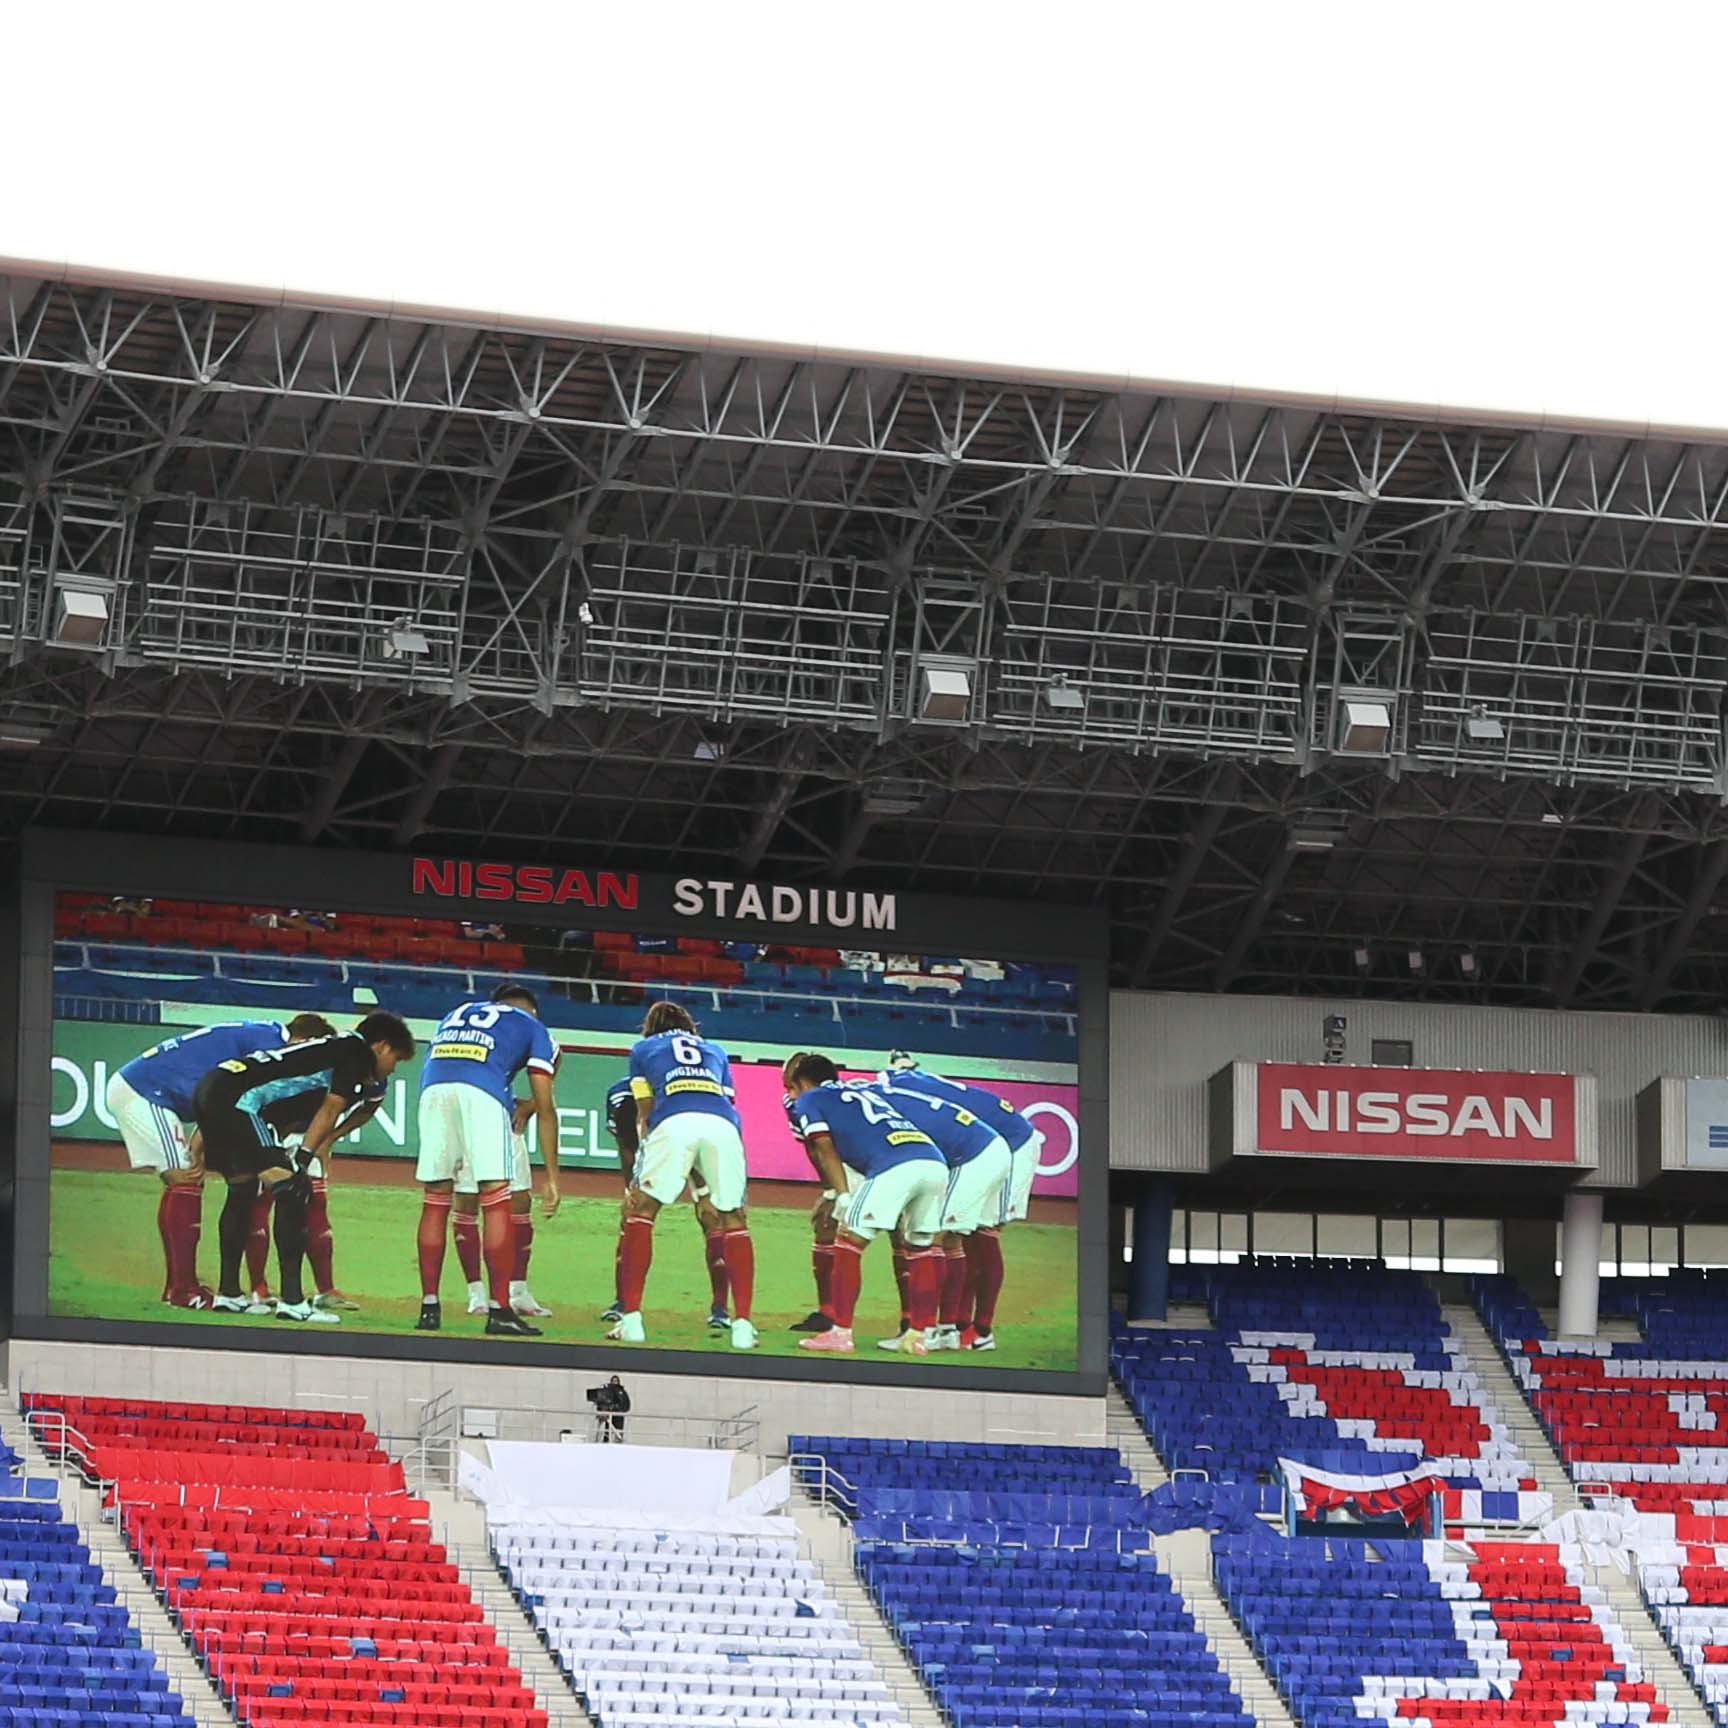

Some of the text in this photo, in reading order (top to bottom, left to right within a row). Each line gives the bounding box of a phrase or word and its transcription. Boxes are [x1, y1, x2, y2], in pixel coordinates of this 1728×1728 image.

[412, 857, 898, 932] NISSAN STADIUM
[672, 1036, 704, 1065] 6
[1280, 1087, 1553, 1140] NISSAN
